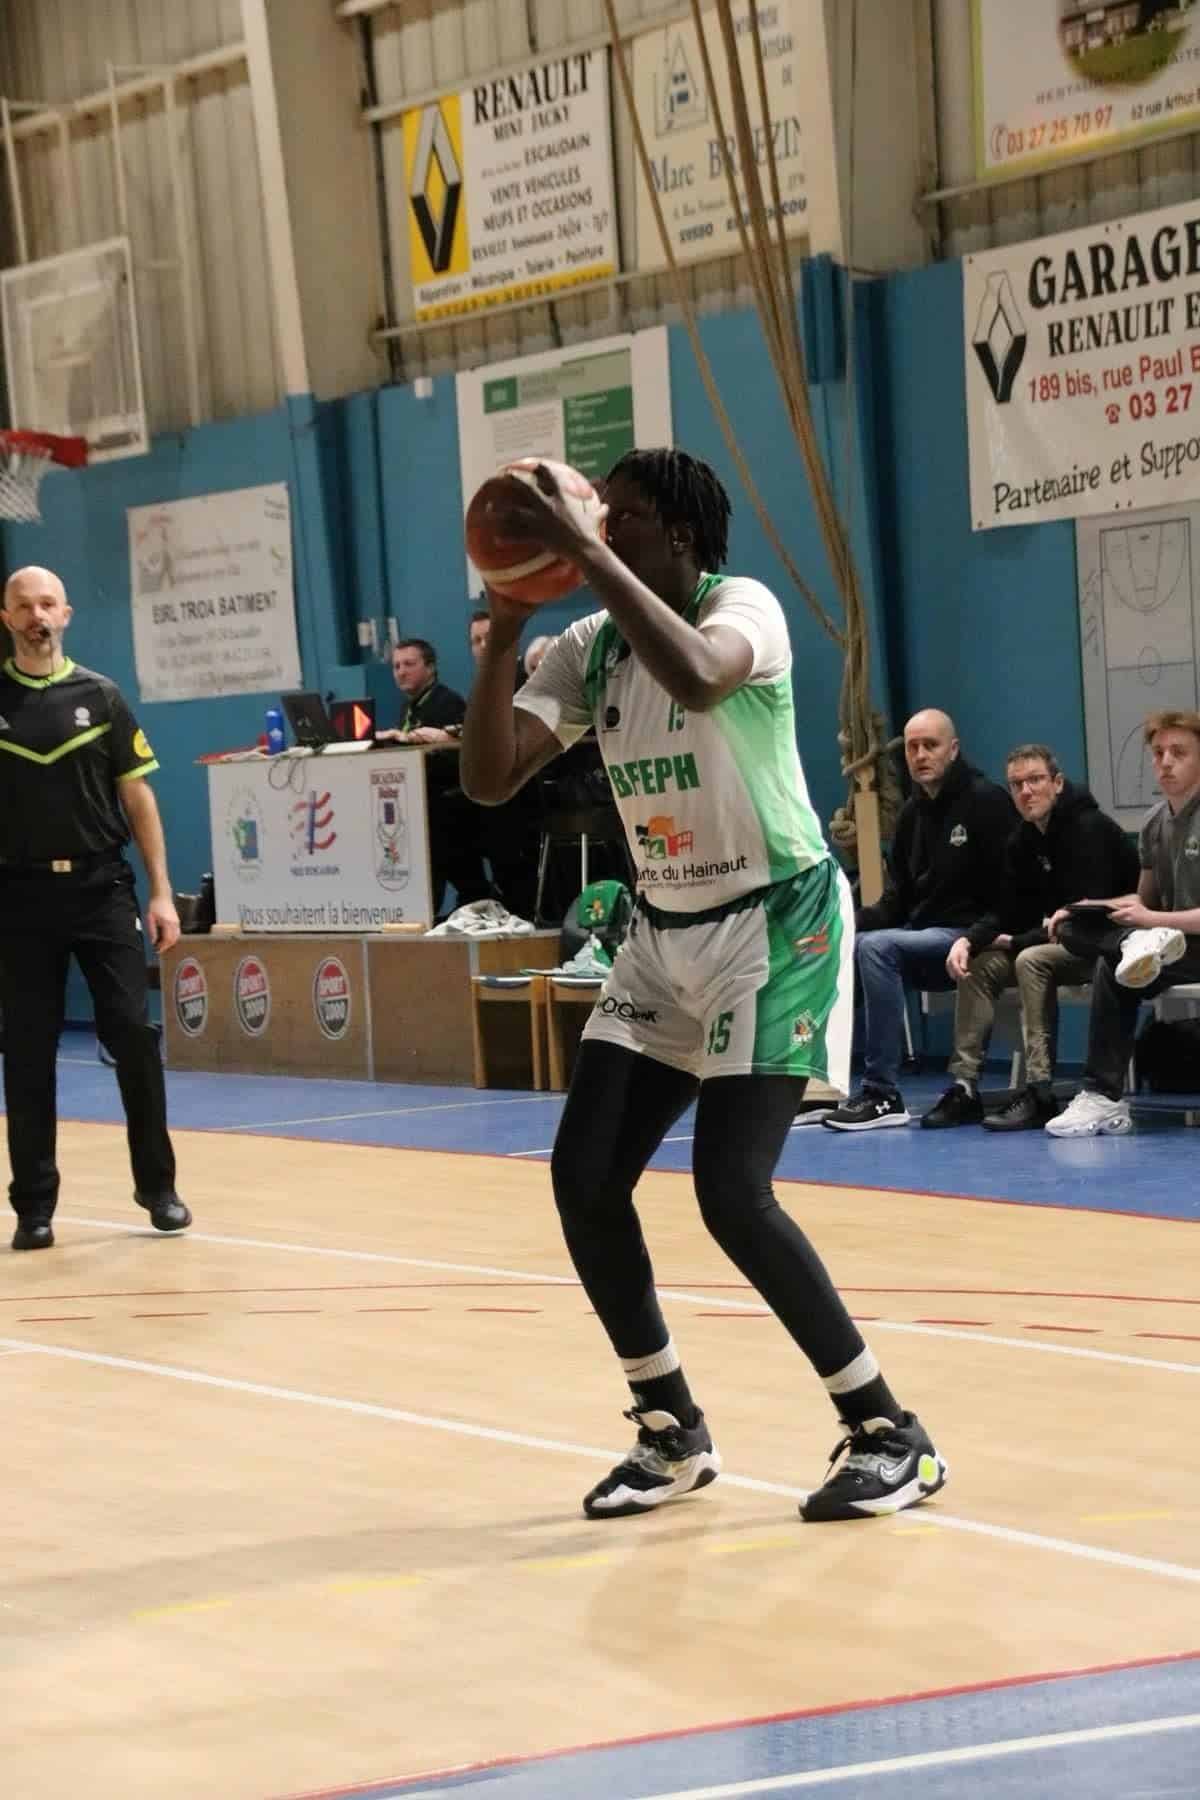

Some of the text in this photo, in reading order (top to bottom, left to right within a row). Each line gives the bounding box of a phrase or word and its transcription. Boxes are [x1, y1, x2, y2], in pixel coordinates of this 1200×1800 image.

[472, 51, 592, 127] RENAULT
[523, 133, 591, 166] ESCAUDAIN
[482, 187, 592, 233] NEUFS ET OCCASIONS
[489, 181, 521, 205] VENTE
[1028, 219, 1200, 309] GARAGE
[1047, 296, 1175, 358] RENAULT
[1028, 372, 1060, 404] 189
[1066, 368, 1098, 397] bis,
[1103, 364, 1133, 391] rue
[1139, 348, 1183, 384] Paul
[1129, 383, 1193, 420] 03 27
[993, 463, 1102, 514] Partenaire
[1109, 452, 1133, 484] et
[662, 863, 679, 881] du
[683, 855, 749, 881] Hainaut
[266, 901, 325, 926] souhaitent
[328, 901, 339, 925] la
[341, 899, 404, 926] bienvenue
